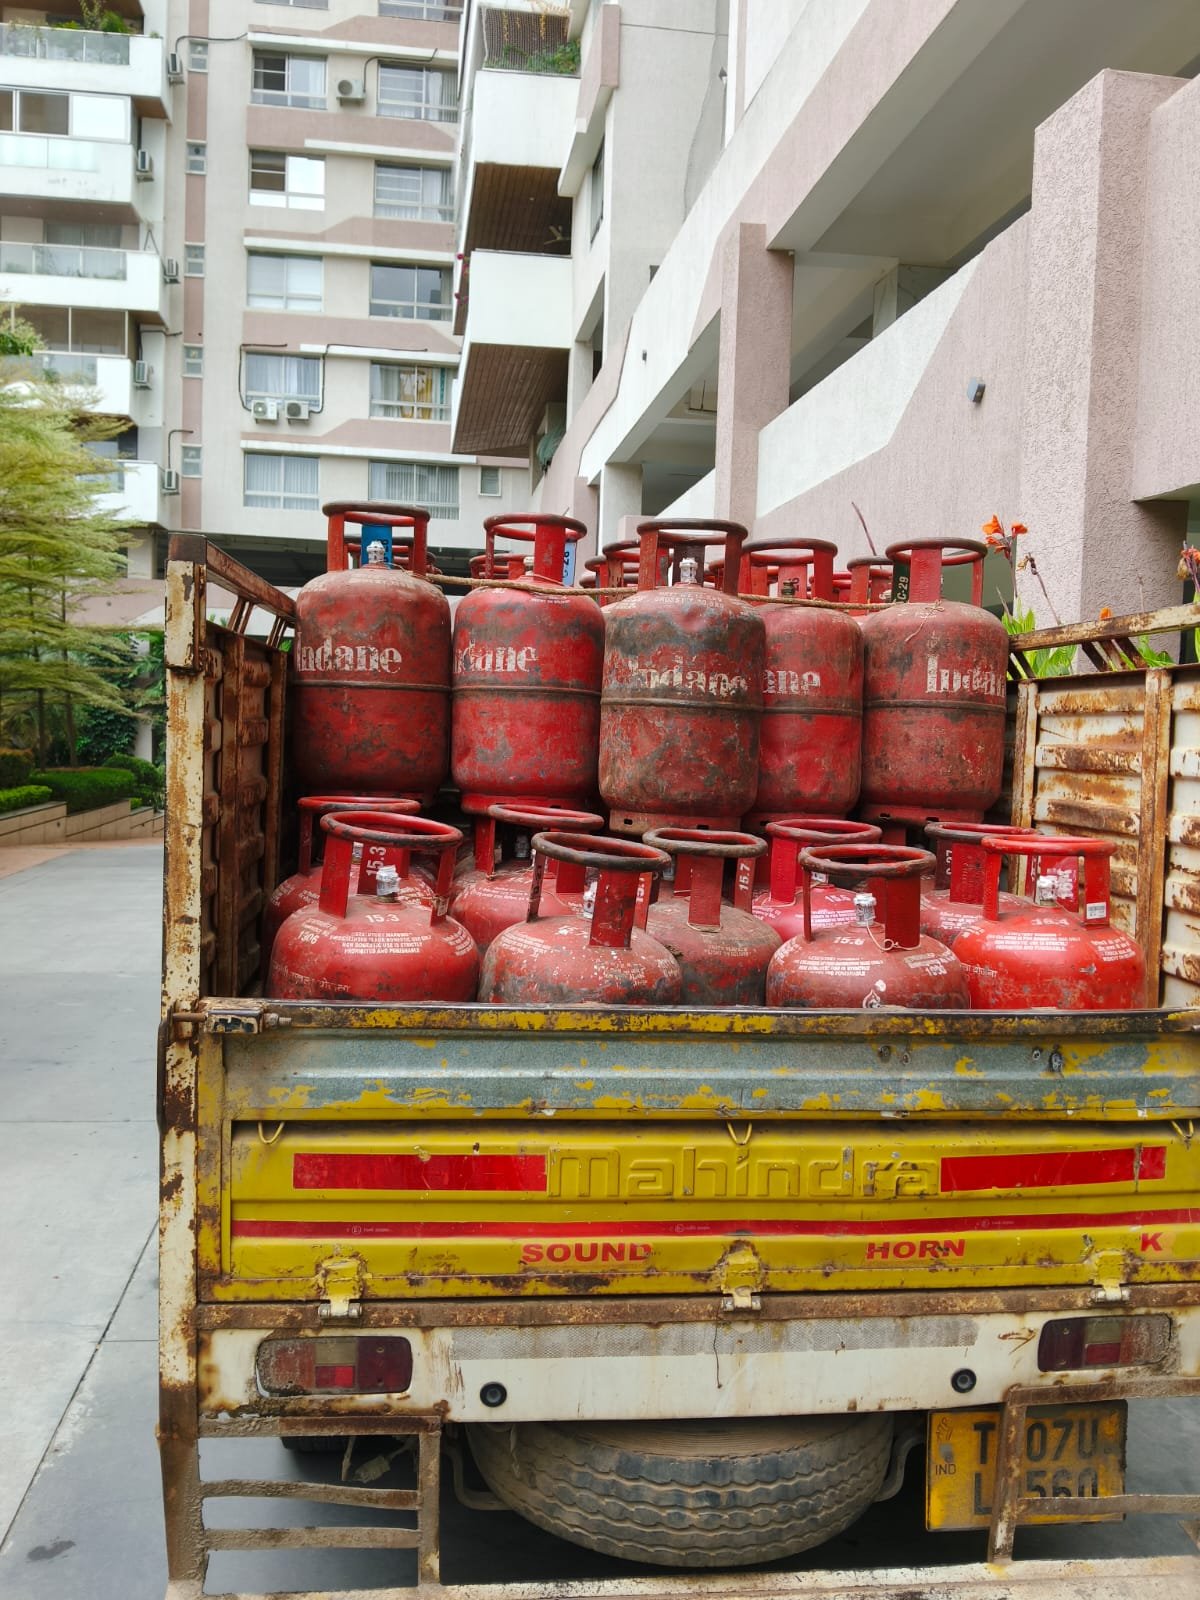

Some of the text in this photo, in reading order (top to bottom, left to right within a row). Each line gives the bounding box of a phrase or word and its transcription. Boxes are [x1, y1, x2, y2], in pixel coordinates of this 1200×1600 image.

[738, 863, 751, 892] 15.7
[365, 913, 400, 924] 15.3
[548, 1146, 940, 1197] mahindra
[522, 1232, 1162, 1264] SOUND HORN K
[935, 1463, 957, 1476] IND
